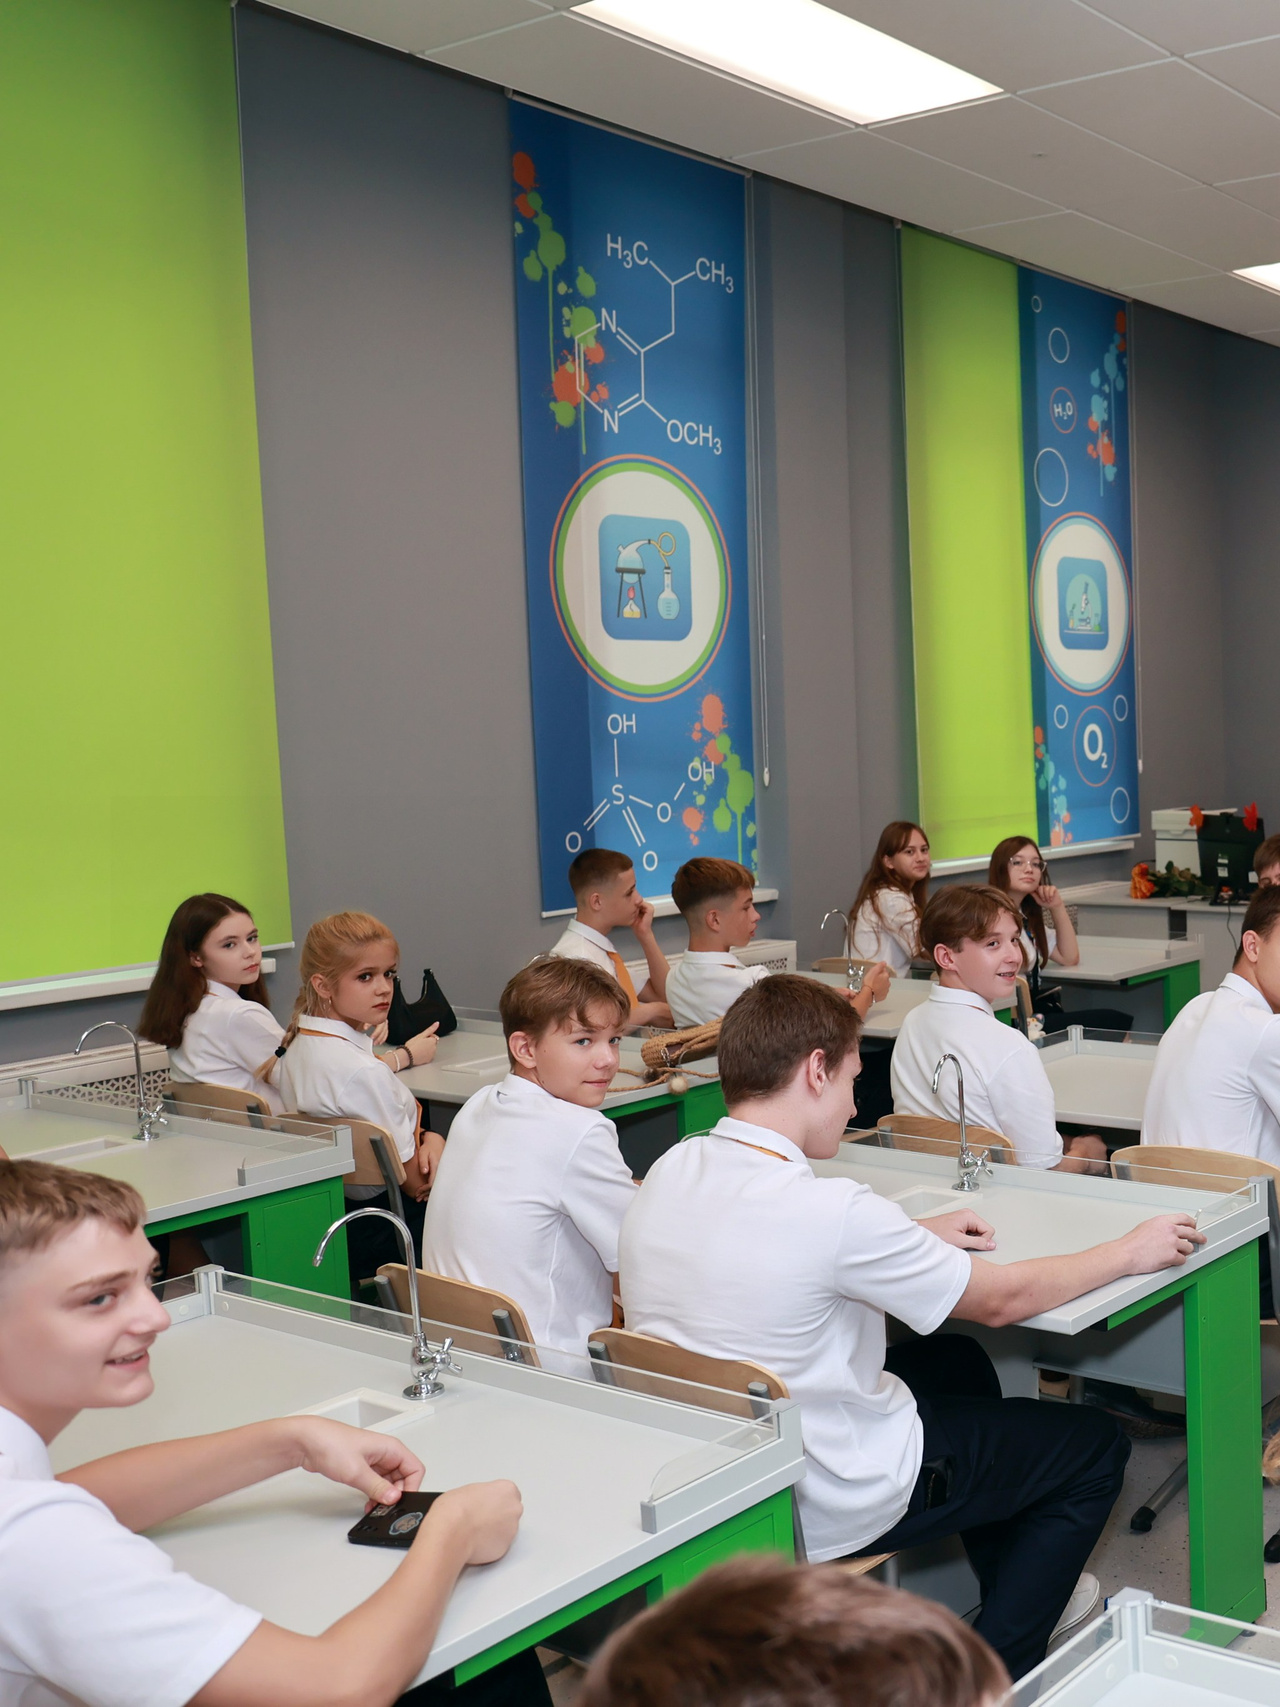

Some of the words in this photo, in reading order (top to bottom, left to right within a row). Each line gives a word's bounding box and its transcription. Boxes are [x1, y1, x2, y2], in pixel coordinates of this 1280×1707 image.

[601, 307, 617, 334] N
[603, 410, 620, 435] N
[607, 713, 636, 735] OH
[687, 761, 715, 782] OH
[611, 784, 625, 806] S
[656, 802, 672, 823] O
[565, 831, 582, 853] O
[642, 851, 658, 872] O
